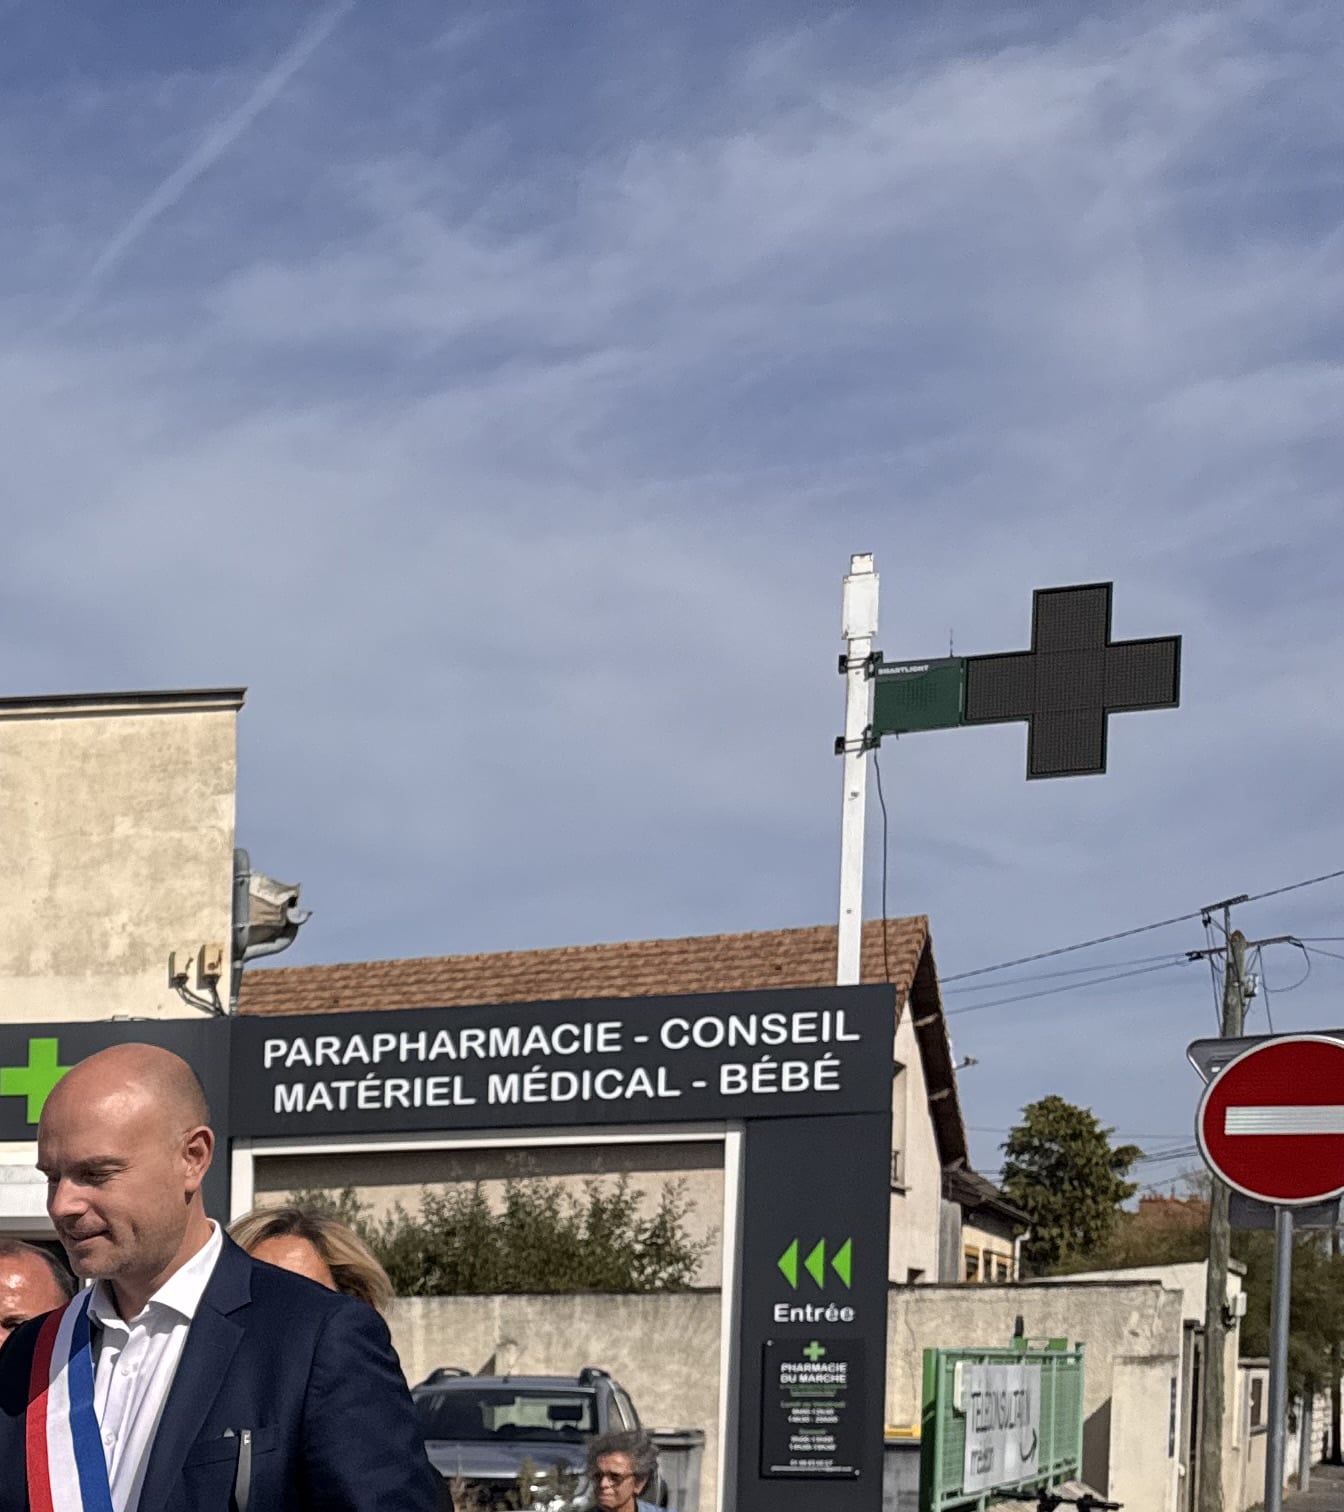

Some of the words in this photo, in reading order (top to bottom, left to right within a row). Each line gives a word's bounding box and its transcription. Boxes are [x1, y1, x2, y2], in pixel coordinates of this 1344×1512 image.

[263, 1020, 623, 1069] PARAPHARMACIE
[660, 1009, 860, 1049] CONSEIL
[273, 1072, 477, 1113] MATÉRIEL
[487, 1064, 681, 1105] MÉDICAL
[719, 1052, 841, 1095] BÉBÉ
[774, 1302, 855, 1322] Entrée
[780, 1362, 847, 1374] PHARMACIE
[780, 1373, 797, 1384] DU
[799, 1373, 847, 1384] MARCHE
